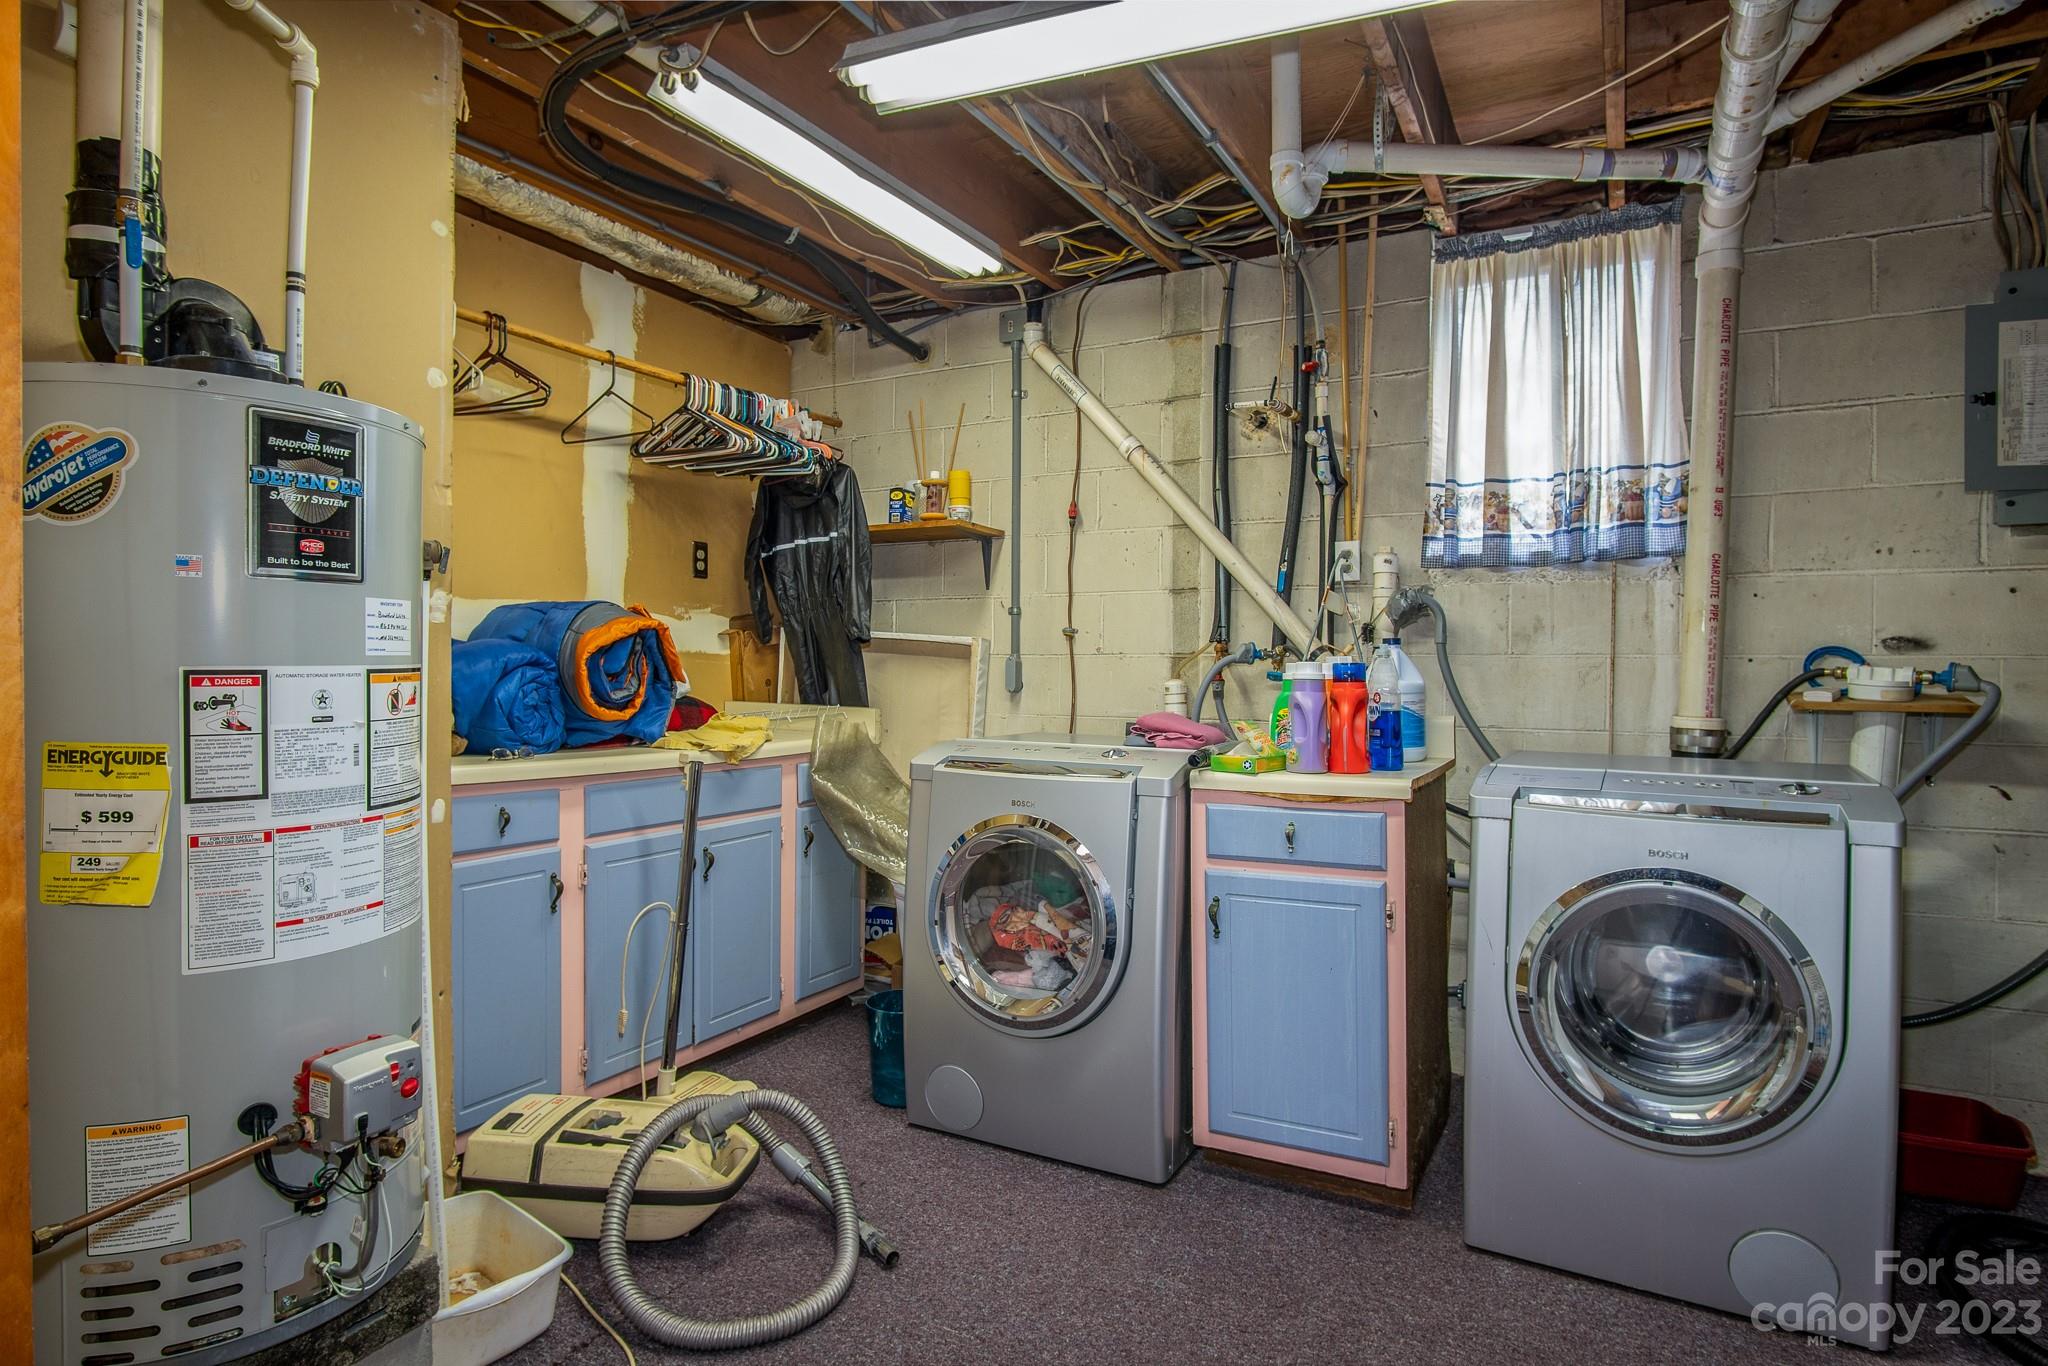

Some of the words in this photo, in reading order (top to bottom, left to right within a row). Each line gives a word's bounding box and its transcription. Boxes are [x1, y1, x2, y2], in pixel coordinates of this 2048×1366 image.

[1721, 298, 1732, 344] CHARLOTTE
[1720, 349, 1729, 367] PIPE
[268, 437, 320, 451] BRADFORD
[323, 445, 351, 456] WHITE
[88, 455, 107, 468] SYSTEM
[23, 455, 86, 503] Hydrojet
[250, 466, 362, 496] DEFENDER
[270, 491, 310, 503] SAFETY
[311, 496, 348, 507] SYSTEM
[331, 561, 349, 569] Best
[1710, 554, 1721, 599] CHARLOTTE
[1710, 604, 1719, 622] PIPE
[48, 749, 166, 765] ENERGYGUIDE
[1012, 799, 1035, 808] BOSCH
[81, 811, 92, 824] $
[98, 811, 134, 823] 599
[77, 858, 101, 866] 249
[1648, 848, 1689, 860] BOSCH
[119, 1124, 161, 1135] WARNING
